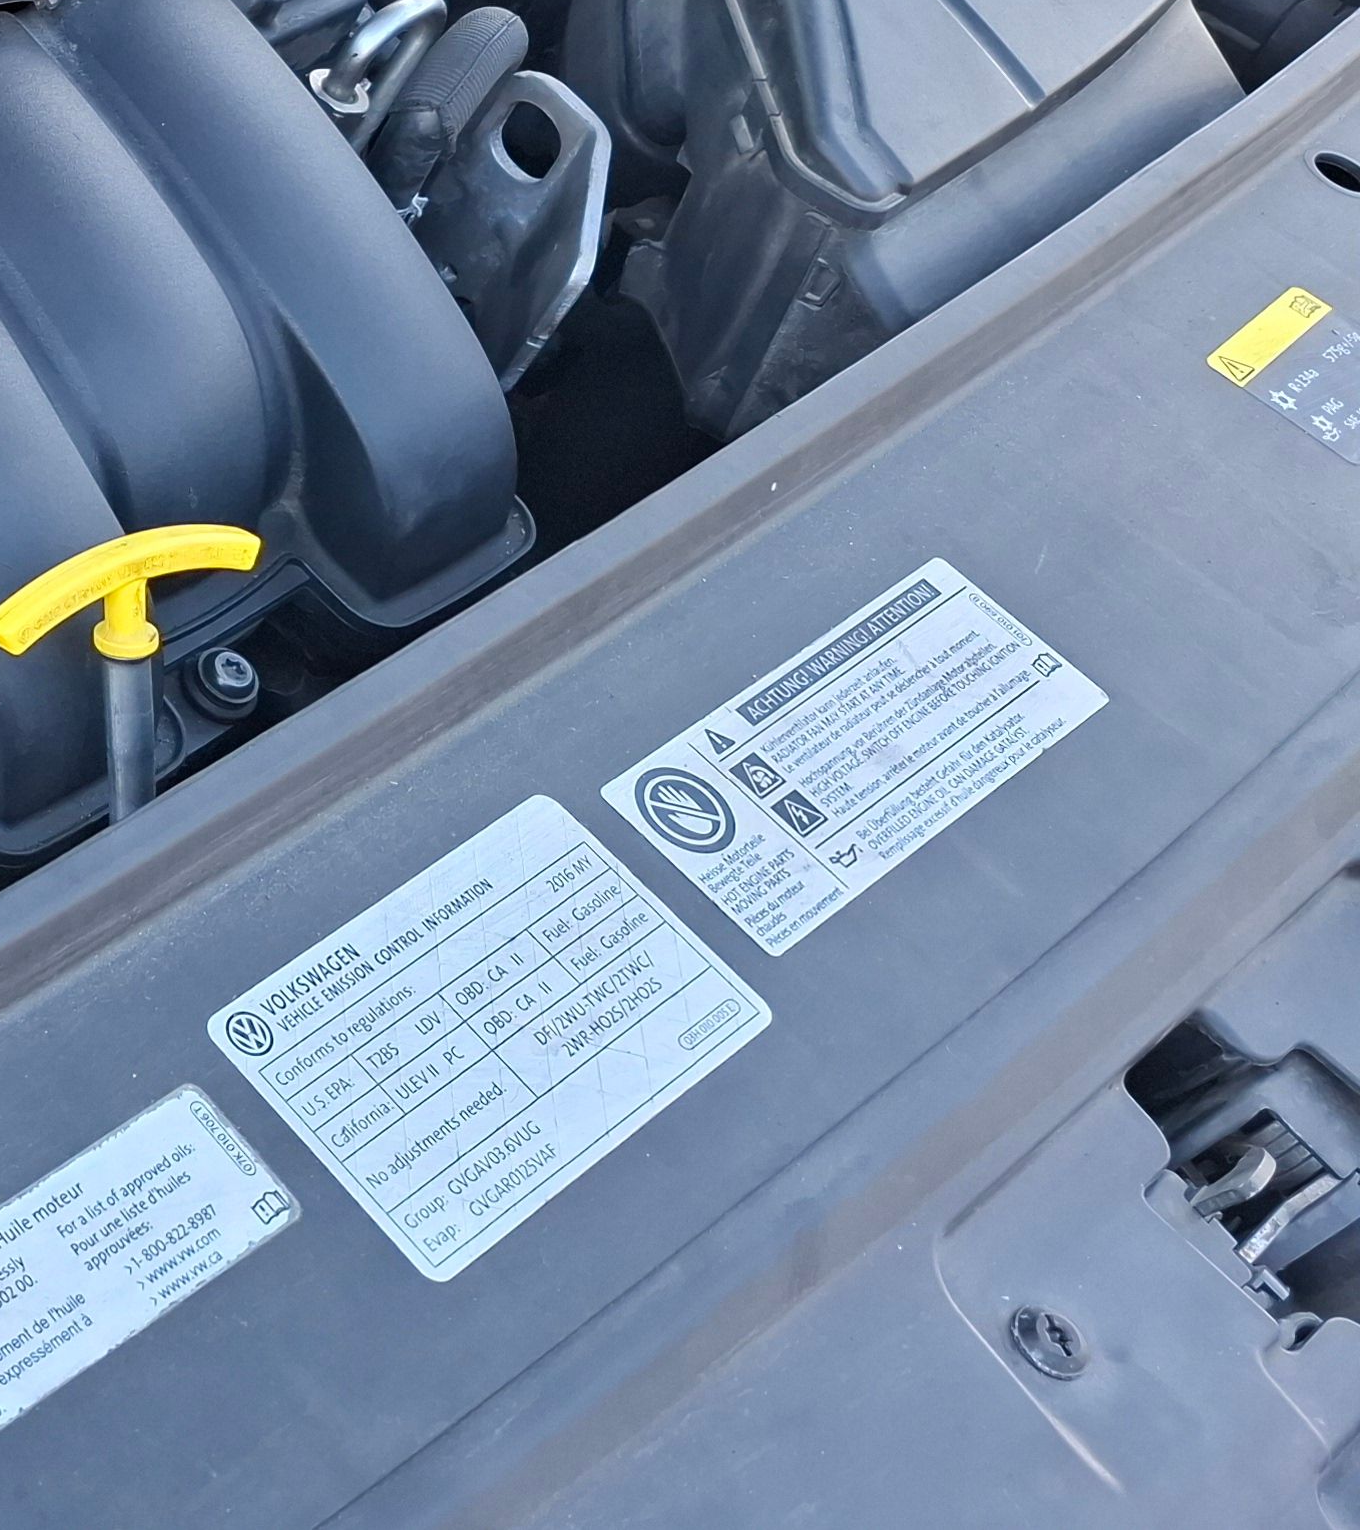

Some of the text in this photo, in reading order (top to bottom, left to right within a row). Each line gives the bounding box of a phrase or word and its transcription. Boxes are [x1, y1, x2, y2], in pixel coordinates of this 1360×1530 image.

[545, 854, 592, 892] 2016 MY
[541, 885, 621, 942] Fuel: Gasoline
[276, 878, 493, 1031] VEHICLE EMISSION CONTROL INFORMATION
[570, 912, 648, 970] Fuel: Gasoline
[259, 943, 360, 1015] VOLKSWAGEN
[455, 981, 488, 1005] OBD:
[487, 965, 508, 981] CA
[275, 986, 416, 1085] Conforms to regulations:
[483, 1010, 516, 1034] OBD:
[515, 993, 536, 1010] CA
[698, 1018, 714, 1033] 010
[365, 1010, 440, 1068] T2B5 LDV
[301, 1078, 355, 1116] U.S. EPA:
[394, 1069, 428, 1099] ULEV
[442, 1045, 464, 1065] PC
[198, 1111, 220, 1134] 706
[215, 1131, 236, 1153] 010
[331, 1101, 394, 1147] California:
[365, 1082, 506, 1189] No adjustments needed.
[231, 1150, 254, 1173] 07K
[403, 1120, 541, 1228] Group: GVGAV03.6VUG
[32, 1182, 83, 1222] moteur
[56, 1143, 195, 1238] For a list of approved oils:
[70, 1171, 190, 1255] Pour une liste d'huiles
[422, 1142, 556, 1252] Evap: GVGAR0125VAF
[83, 1221, 153, 1271] approuvées:
[145, 1228, 221, 1283] www.vw.com
[157, 1250, 222, 1298] www.vw.ca
[32, 1318, 49, 1333] de
[47, 1293, 85, 1321] l'huile
[80, 1313, 92, 1326] à
